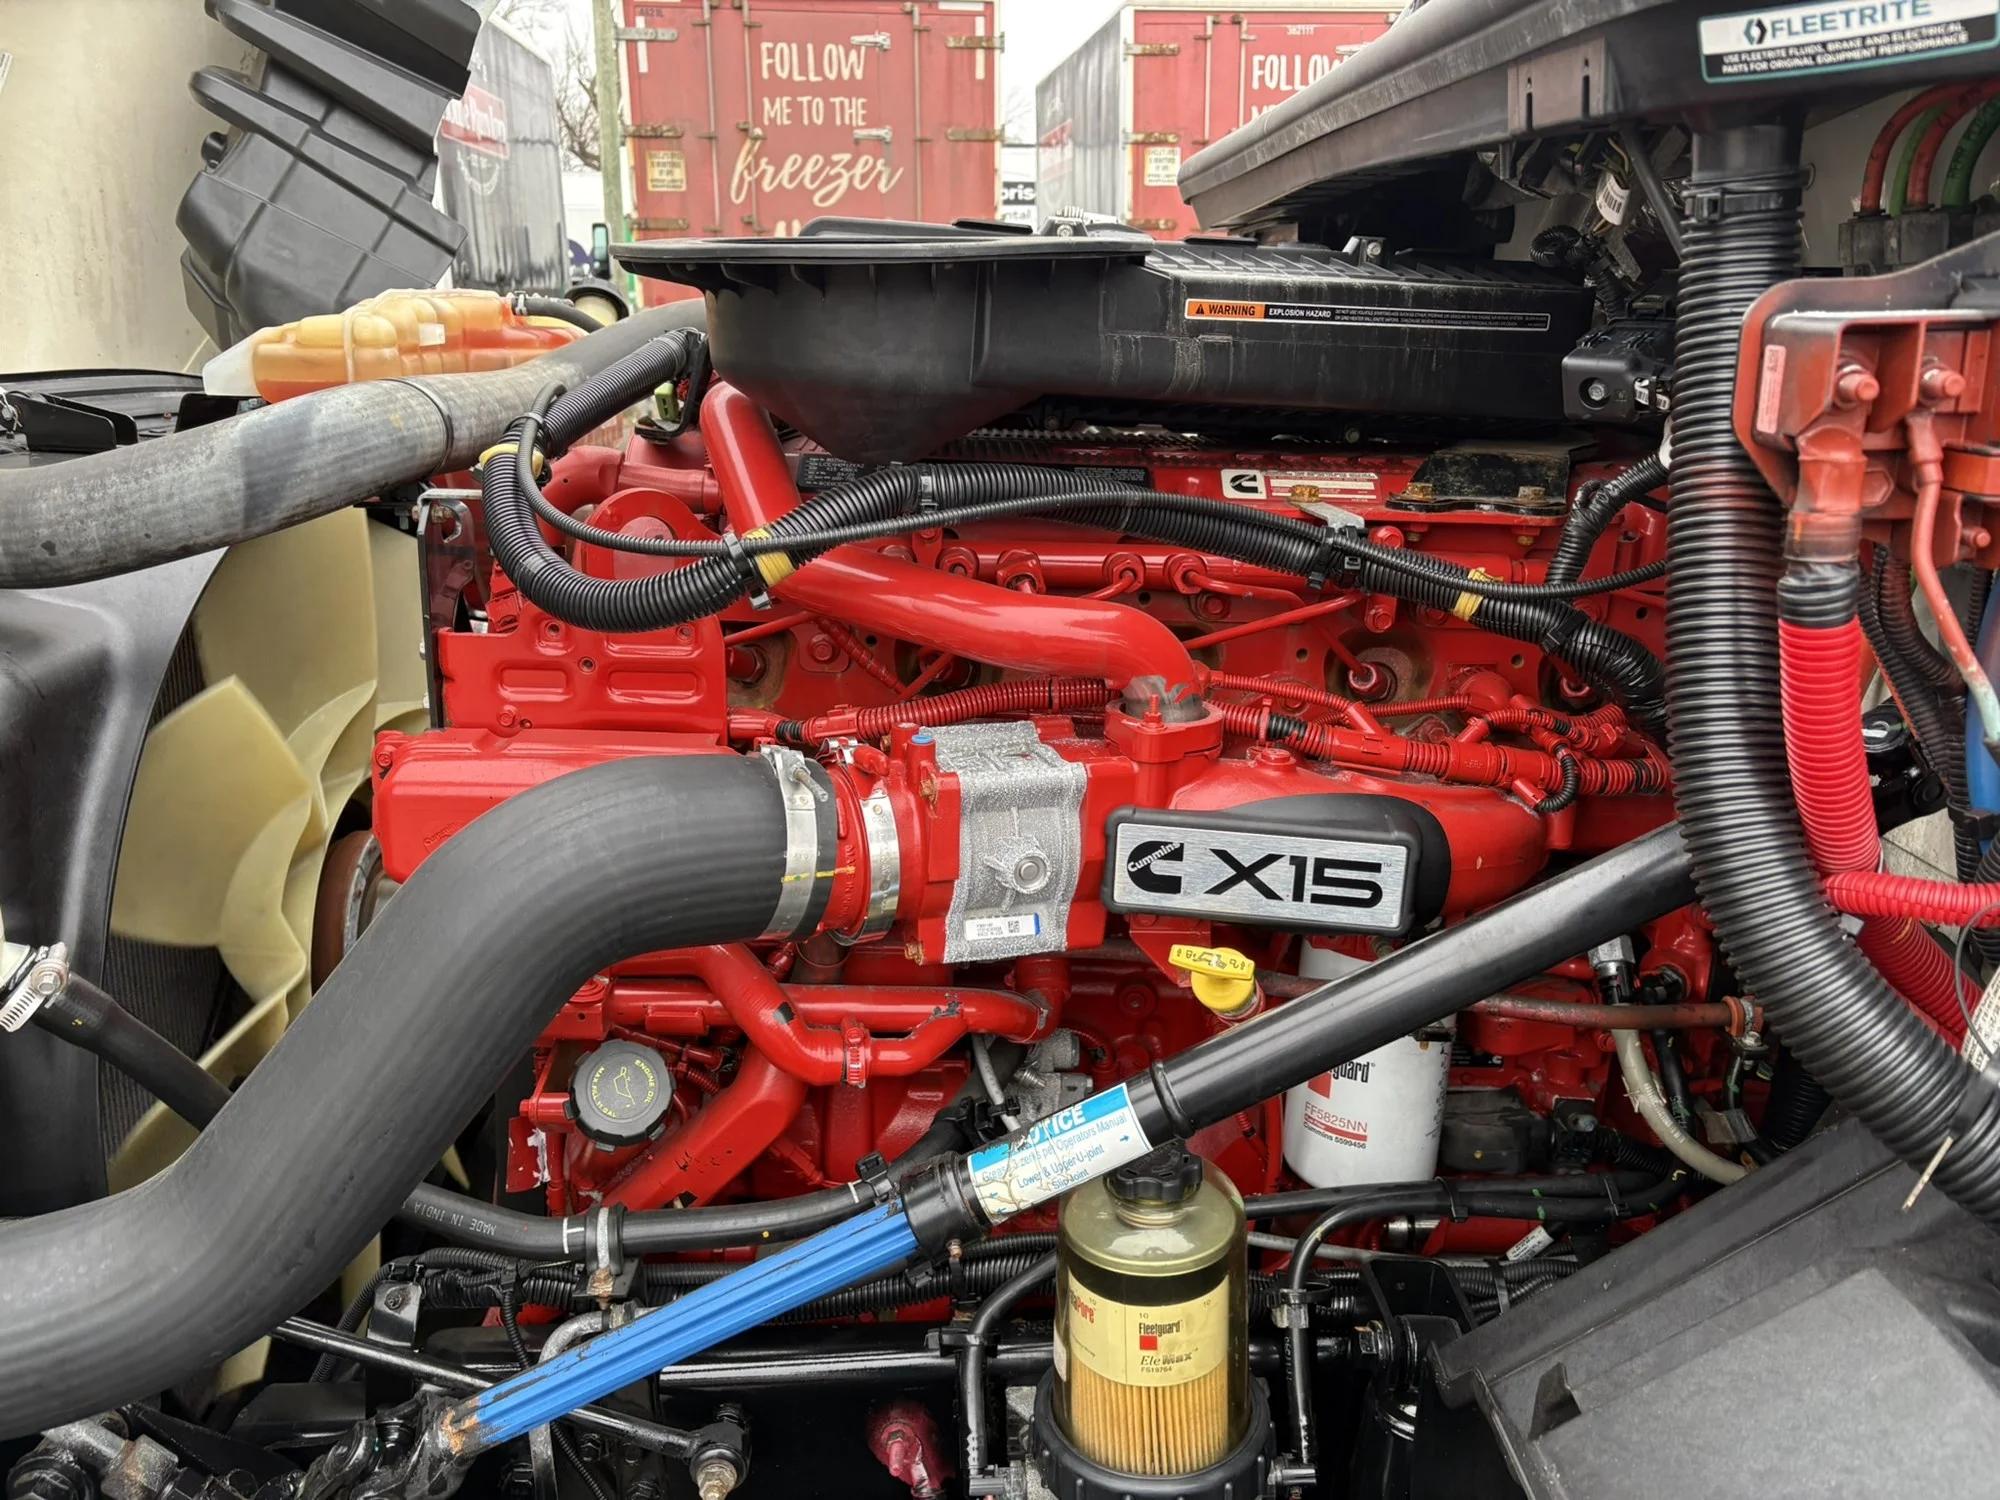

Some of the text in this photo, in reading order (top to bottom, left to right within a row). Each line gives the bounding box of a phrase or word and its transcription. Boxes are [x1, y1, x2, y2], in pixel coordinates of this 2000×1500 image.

[1771, 0, 1932, 39] FLEETRITE
[760, 42, 866, 82] FOLLOW
[1723, 53, 1740, 63] USE
[1741, 48, 1787, 61] FLEETRITE
[1864, 33, 1890, 46] AND
[1722, 63, 1748, 74] PARTS
[1749, 61, 1769, 71] FOR
[1769, 56, 1815, 70] ORIGINAL
[763, 96, 867, 127] ME TO THE
[730, 134, 904, 207] freezer
[1208, 304, 1256, 316] WARNING
[1269, 307, 1305, 317] EXPLOSION
[1305, 309, 1332, 318] HAZARD
[1127, 842, 1384, 909] Cummins X15
[593, 1066, 605, 1083] MAX
[634, 1060, 656, 1103] ENGINE OIL
[1329, 1061, 1370, 1083] guard
[1016, 1104, 1087, 1150] OTICE
[1096, 1111, 1128, 1134] Manual
[1304, 1101, 1368, 1132] FF5825NN
[1304, 1121, 1333, 1141] Cummins
[1017, 1171, 1043, 1189] Lower
[414, 1201, 497, 1236] MADE IN INDIA
[1139, 1320, 1181, 1337] Fleetguard
